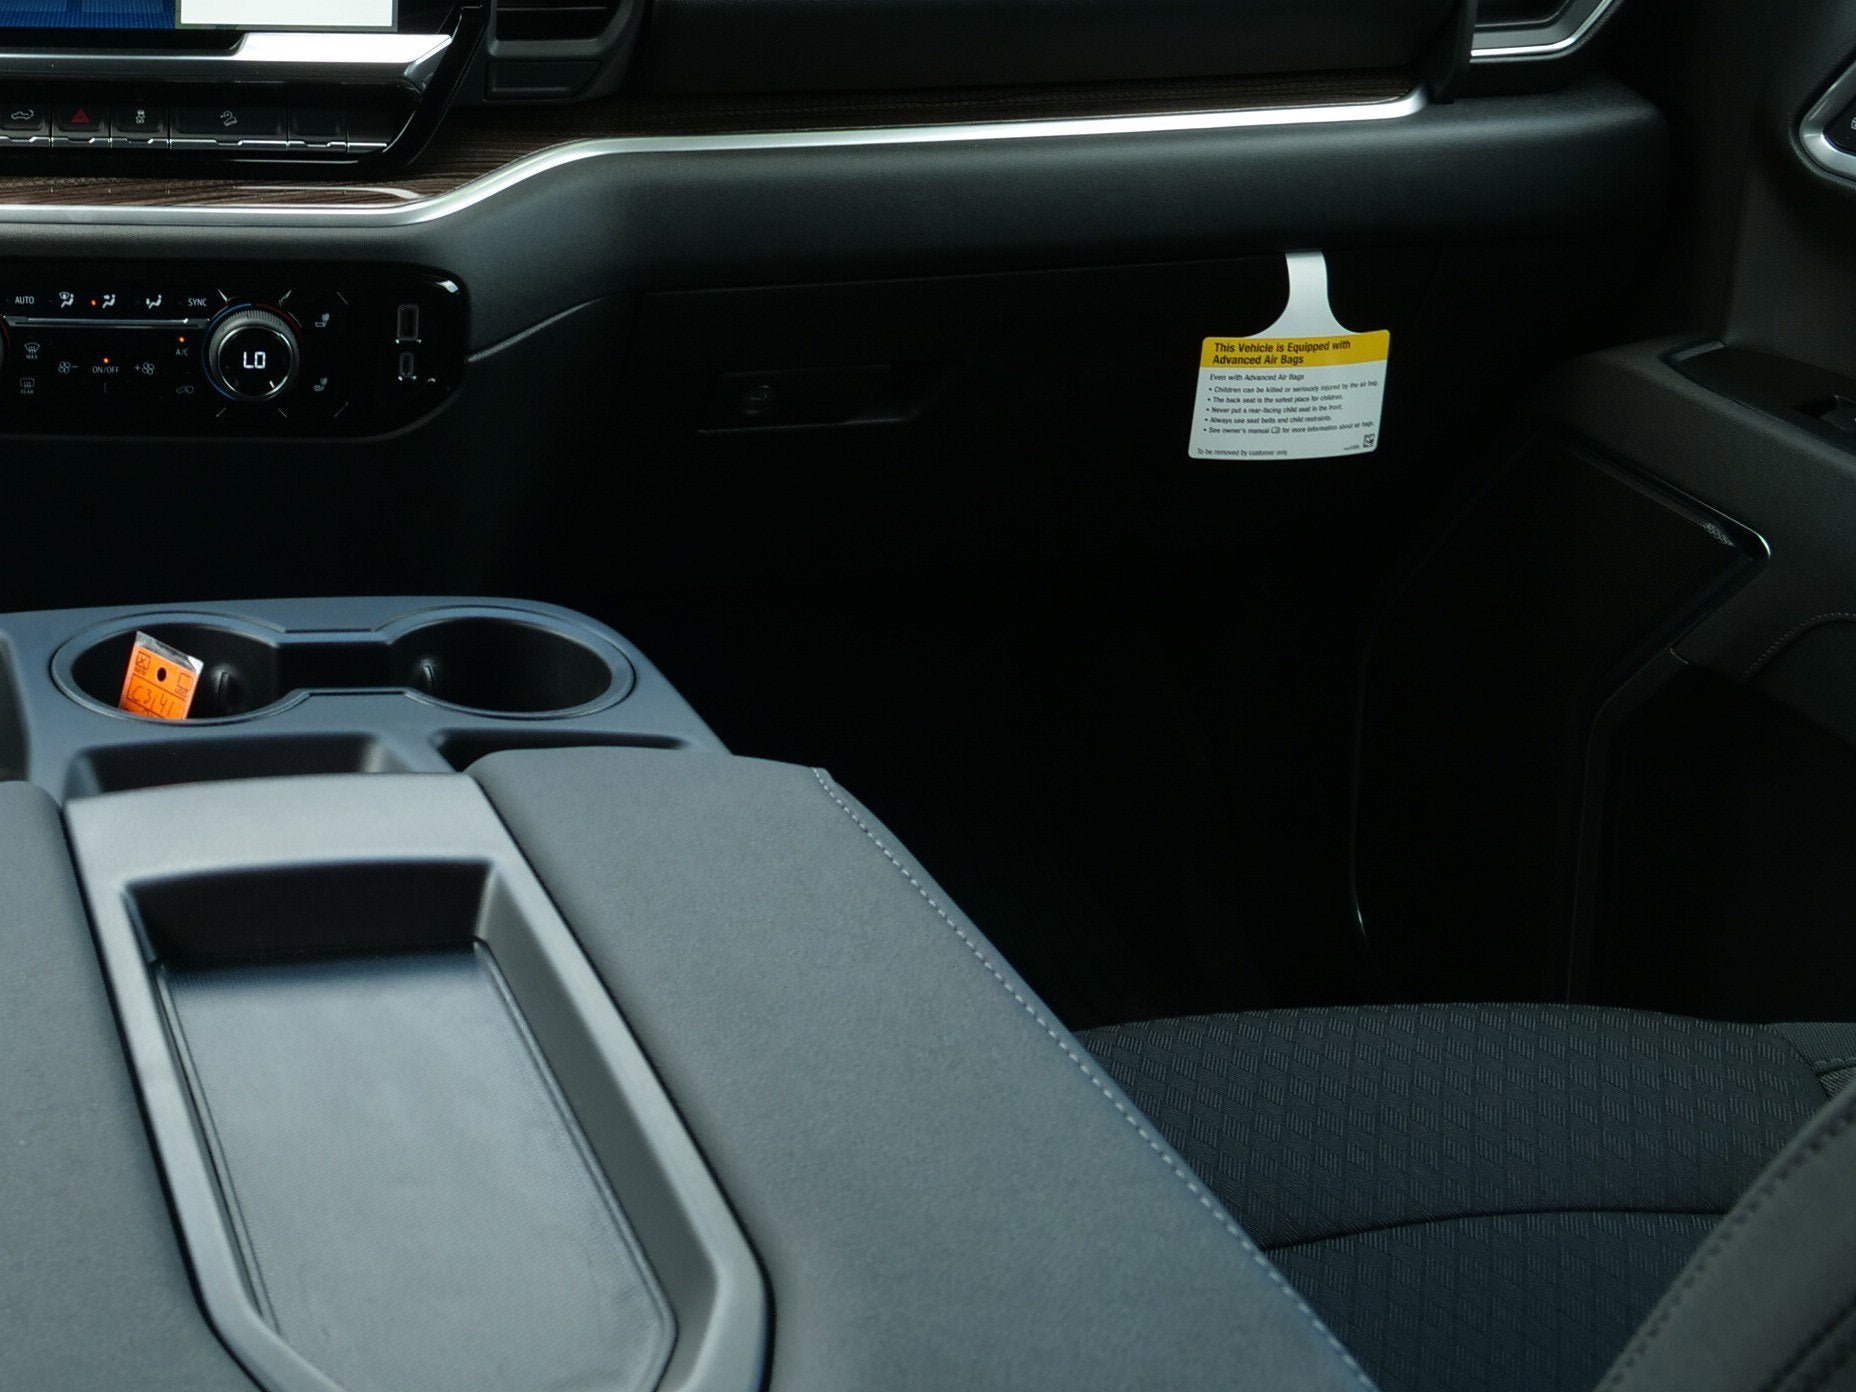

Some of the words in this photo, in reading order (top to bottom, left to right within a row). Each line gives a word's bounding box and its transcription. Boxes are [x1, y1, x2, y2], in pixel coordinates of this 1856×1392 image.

[14, 296, 35, 305] AUTO
[187, 298, 207, 307] SYNC
[1214, 342, 1235, 353] This
[1238, 343, 1273, 353] Vehicle
[1276, 343, 1285, 352] is
[1287, 341, 1330, 354] Equipped
[1332, 340, 1351, 350] with
[243, 351, 265, 369] LO
[1213, 355, 1262, 365] Advanced
[1265, 354, 1278, 364] Air
[1281, 355, 1304, 366] Bags
[92, 366, 120, 374] ON/OFF
[1209, 373, 1227, 381] Even
[1288, 373, 1304, 381] Bags
